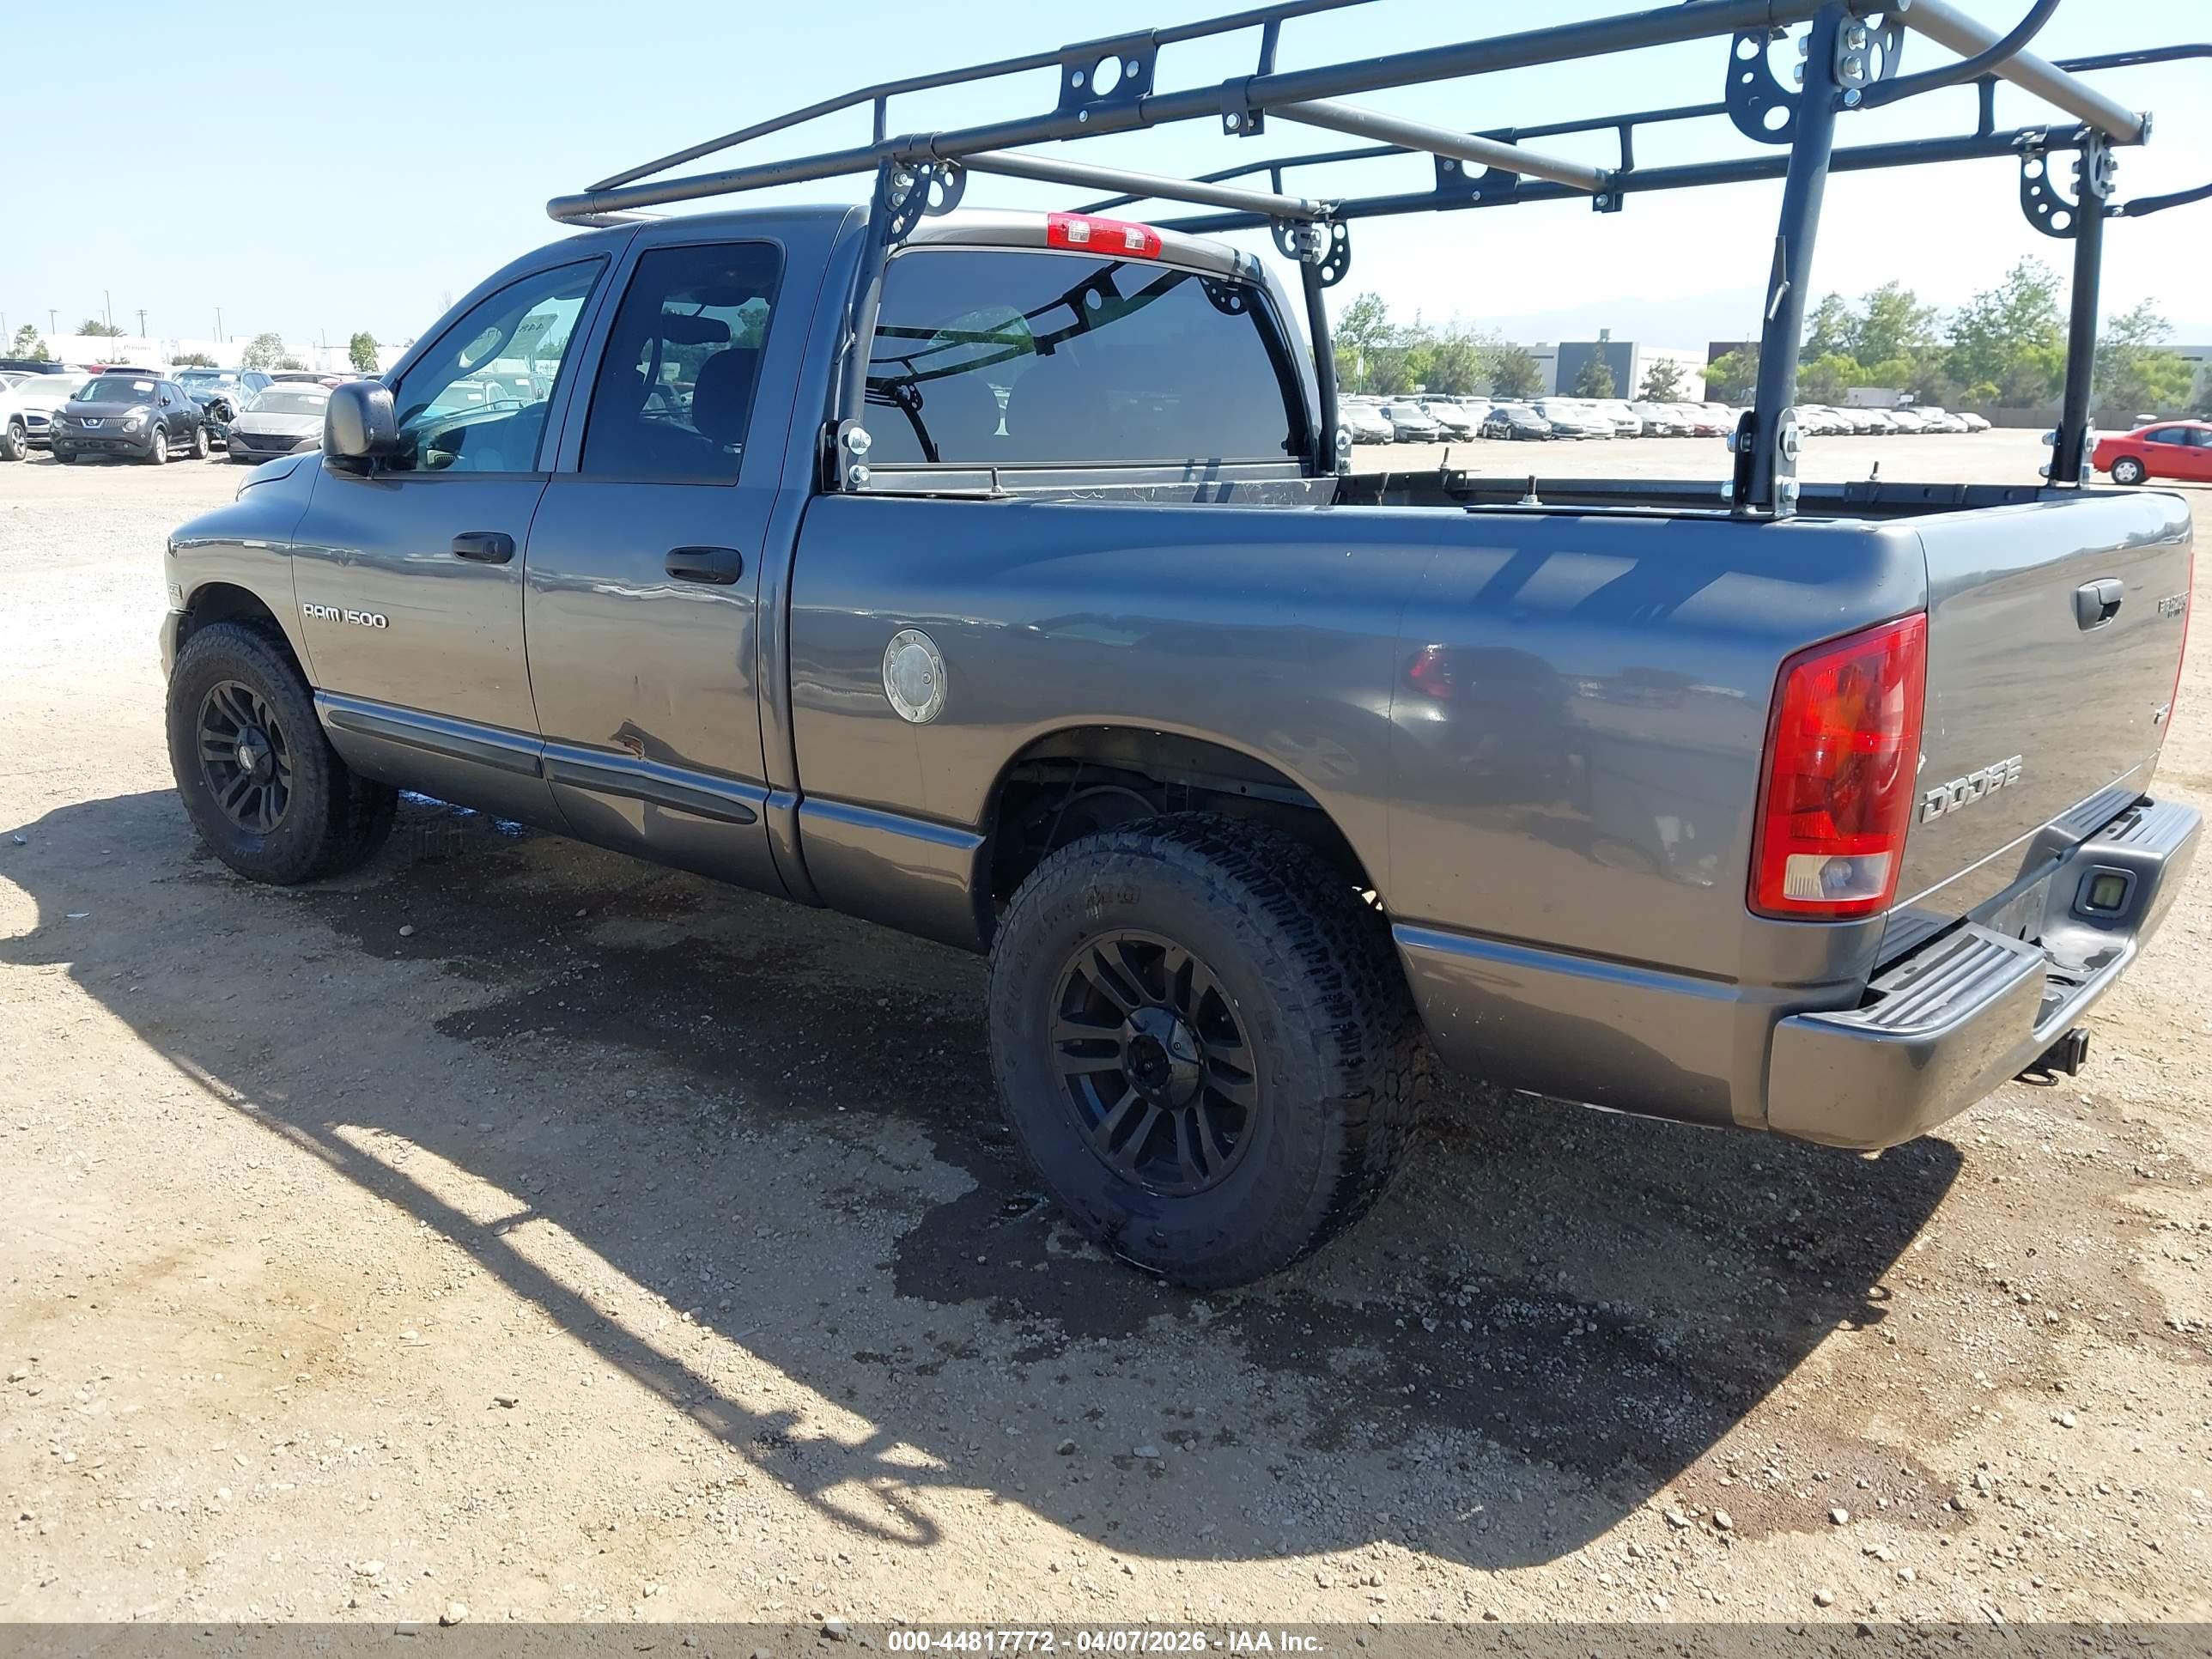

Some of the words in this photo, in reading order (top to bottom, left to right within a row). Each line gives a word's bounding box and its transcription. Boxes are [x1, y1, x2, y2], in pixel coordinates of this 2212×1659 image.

[303, 603, 342, 623] RAM
[343, 609, 389, 629] 1500
[1920, 754, 2024, 824] DODGE
